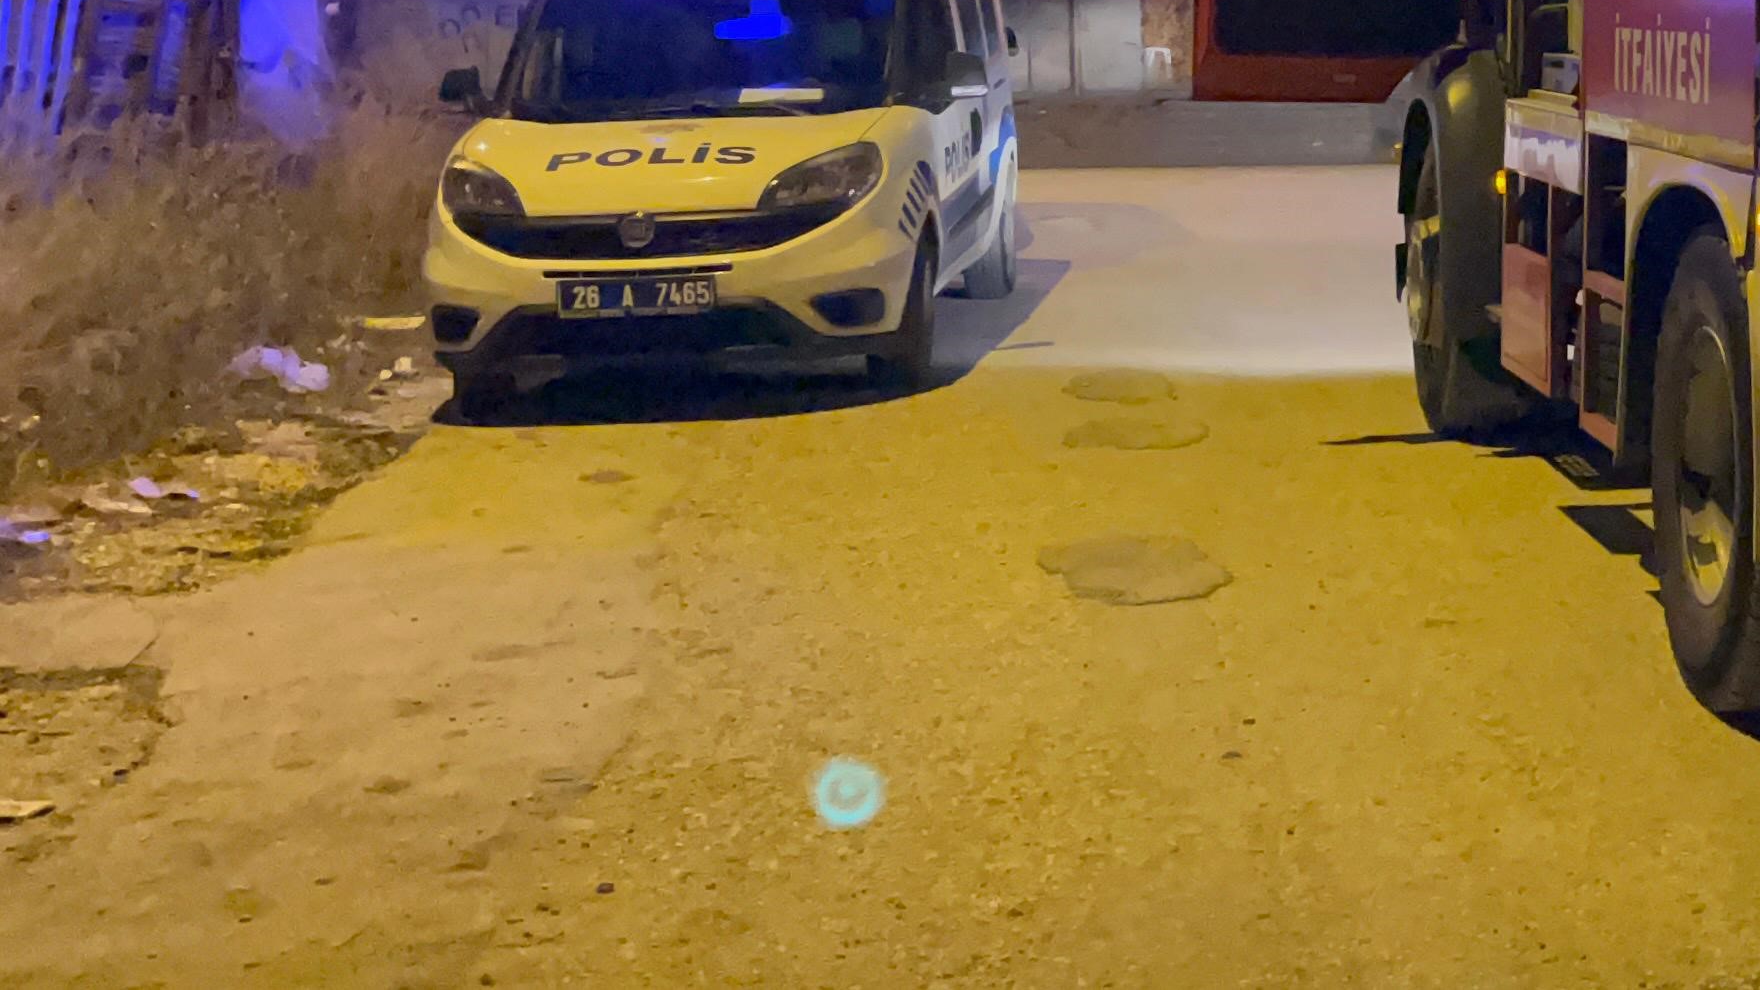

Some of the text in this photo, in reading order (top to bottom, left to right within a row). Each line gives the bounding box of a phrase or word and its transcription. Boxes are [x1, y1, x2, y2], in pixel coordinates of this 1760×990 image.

[1614, 12, 1711, 105] İTFAİYESİ
[545, 142, 757, 172] POLİS
[572, 281, 710, 309] 26 A 7465
